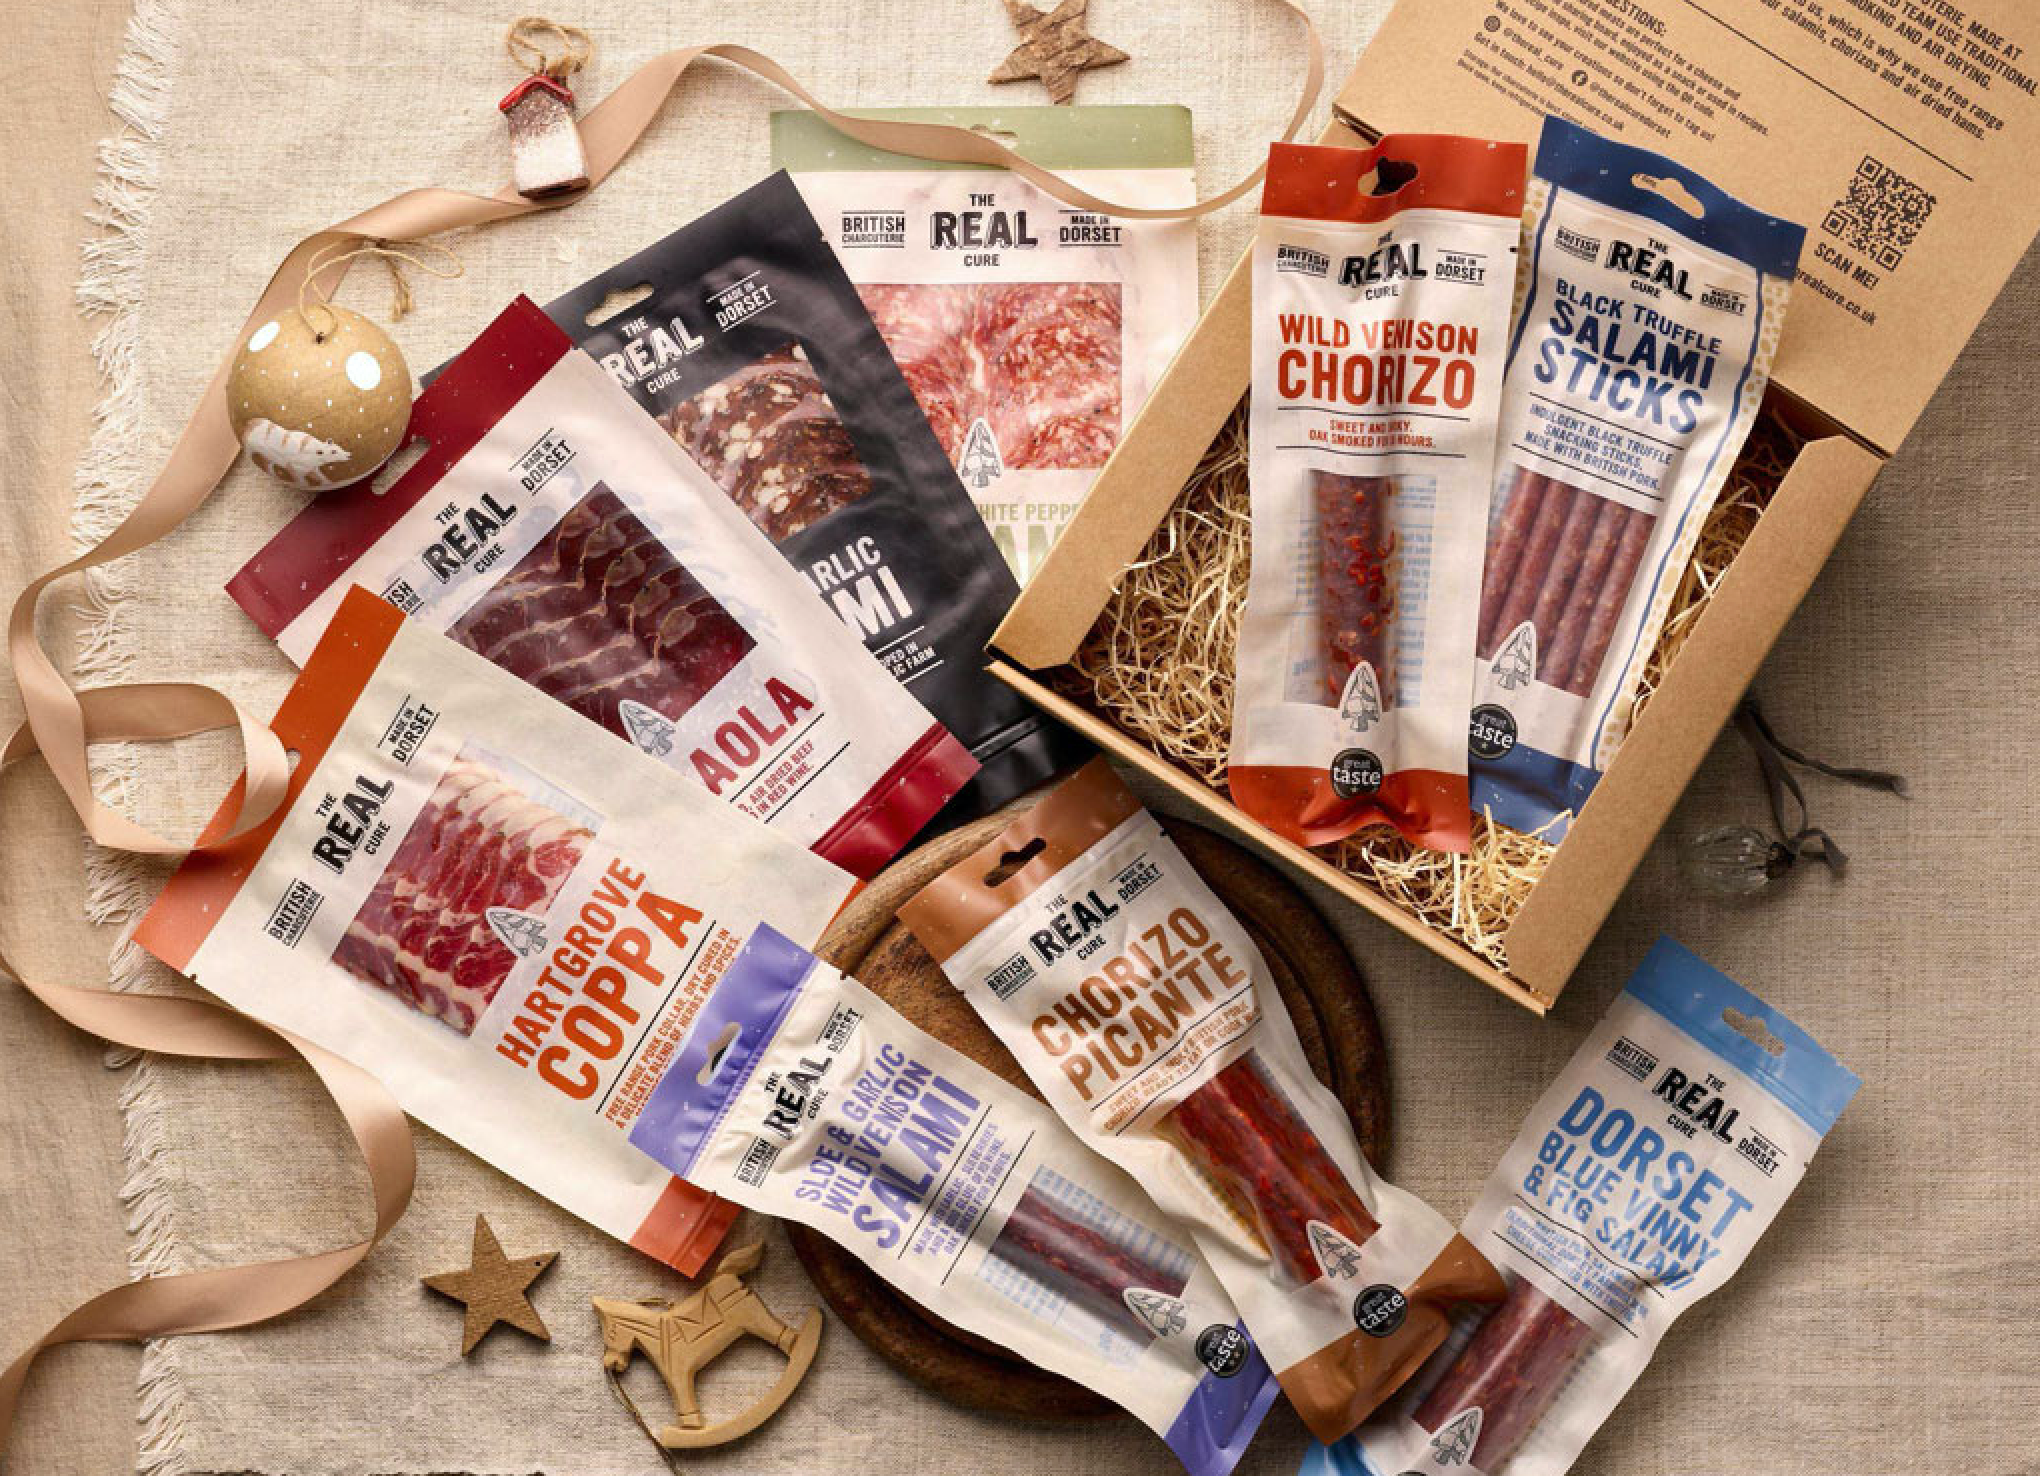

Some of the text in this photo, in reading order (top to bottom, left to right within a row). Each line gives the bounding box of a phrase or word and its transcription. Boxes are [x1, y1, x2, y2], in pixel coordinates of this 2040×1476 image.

[1894, 22, 1923, 44] AND
[1921, 39, 1945, 60] AIR
[1944, 51, 1991, 90] DRYING.
[1902, 1, 2038, 96] TEAM USE TRADITIONAL
[1967, 20, 2023, 61] MADE AT
[1640, 34, 1673, 58] perfect
[1693, 68, 1724, 90] cheese
[1723, 86, 1741, 100] and
[1781, 6, 1984, 140] salamis, chorizos and air dried hams.
[1828, 14, 1862, 42] which
[1862, 35, 1876, 50] is
[1876, 44, 1902, 66] why
[1899, 59, 1922, 80] we
[1920, 73, 1943, 92] use
[1943, 86, 1969, 109] free
[1969, 104, 2004, 131] range
[969, 193, 995, 207] THE
[1071, 215, 1096, 225] MADE
[842, 216, 905, 232] BRITISH
[930, 210, 1038, 250] REAL
[1060, 226, 1122, 242] DORSET
[1554, 227, 1600, 253] BRITISH
[964, 254, 1000, 267] CURE
[1275, 248, 1329, 268] BRITISH
[1338, 244, 1427, 286] REAL
[1648, 238, 1668, 254] THE
[1814, 242, 1880, 290] SCAN ME!
[1436, 263, 1485, 281] DORSET
[1604, 240, 1693, 301] REAL
[1630, 280, 1661, 298] CURE
[716, 284, 771, 327] DORSET
[1364, 285, 1399, 300] CURE
[1700, 290, 1748, 316] DORSET
[621, 316, 649, 337] THE
[1279, 314, 1479, 356] WILD VENISON
[1556, 278, 1722, 355] BLACK TRUFFLE
[597, 313, 704, 395] REAL
[1543, 299, 1716, 390] SALAMI
[647, 367, 681, 394] CURE
[1278, 349, 1475, 408] CHORIZO
[1534, 338, 1703, 439] STICKS
[1309, 429, 1374, 448] OAK SMOKED
[1330, 419, 1366, 433] SWEET
[1587, 425, 1624, 447] BLACK
[1627, 438, 1675, 467] TRUFFLE
[521, 439, 571, 492] DORSET
[1544, 426, 1642, 470] SNACKING STICKS.
[1554, 442, 1582, 460] WITH
[1583, 453, 1628, 478] BRITISH
[434, 502, 460, 525] THE
[976, 504, 1018, 520] HITE
[422, 493, 517, 584] REAL
[474, 543, 505, 574] CURE
[387, 581, 413, 609] ISH
[832, 566, 913, 646] MI
[905, 641, 919, 654] IN
[905, 646, 936, 669] FARM
[388, 718, 408, 744] MADE
[392, 703, 434, 763] DORSET
[689, 677, 814, 796] AOLA
[749, 740, 814, 804] AIR DRIED BEEF
[1333, 766, 1380, 785] taste
[315, 793, 338, 818] THE
[754, 797, 771, 816] IN
[765, 781, 789, 806] RED
[312, 776, 393, 874] REAL
[364, 820, 391, 855] CURE
[1118, 863, 1159, 900] DORSET
[268, 881, 312, 940] BRITISH
[1045, 893, 1069, 913] THE
[1030, 889, 1120, 967] REAL
[1076, 934, 1106, 960] CURE
[496, 859, 646, 1067] HARTGROVE
[987, 956, 1029, 991] BRITISH
[537, 891, 704, 1100] COPPA
[1030, 907, 1210, 1064] CHORIZO
[605, 1096, 626, 1121] FREE
[620, 1064, 646, 1096] RANGE
[640, 1036, 663, 1064] PORK
[684, 973, 701, 996] DRY
[697, 941, 722, 974] CURED
[716, 926, 730, 942] IN
[1056, 941, 1247, 1101] PICANTE
[1613, 1040, 1656, 1072] BRITISH
[761, 1069, 782, 1095] THE
[763, 1057, 832, 1141] REAL
[1705, 1073, 1726, 1092] THE
[803, 1086, 829, 1121] CURE
[1651, 1067, 1739, 1143] REAL
[792, 1044, 905, 1208] SLOE & GARLIC
[824, 1059, 933, 1214] WILD VENISON
[1667, 1114, 1698, 1139] CURE
[854, 1075, 980, 1248] SALAMI
[1556, 1085, 1752, 1223] DORSET
[1738, 1137, 1779, 1173] DORSET
[1520, 1161, 1550, 1198] &
[1545, 1180, 1593, 1224] FIG
[1538, 1129, 1621, 1204] BLUE
[1630, 1188, 1718, 1272] VINNY
[1360, 1294, 1404, 1329] taste
[1209, 1330, 1241, 1372] taste
